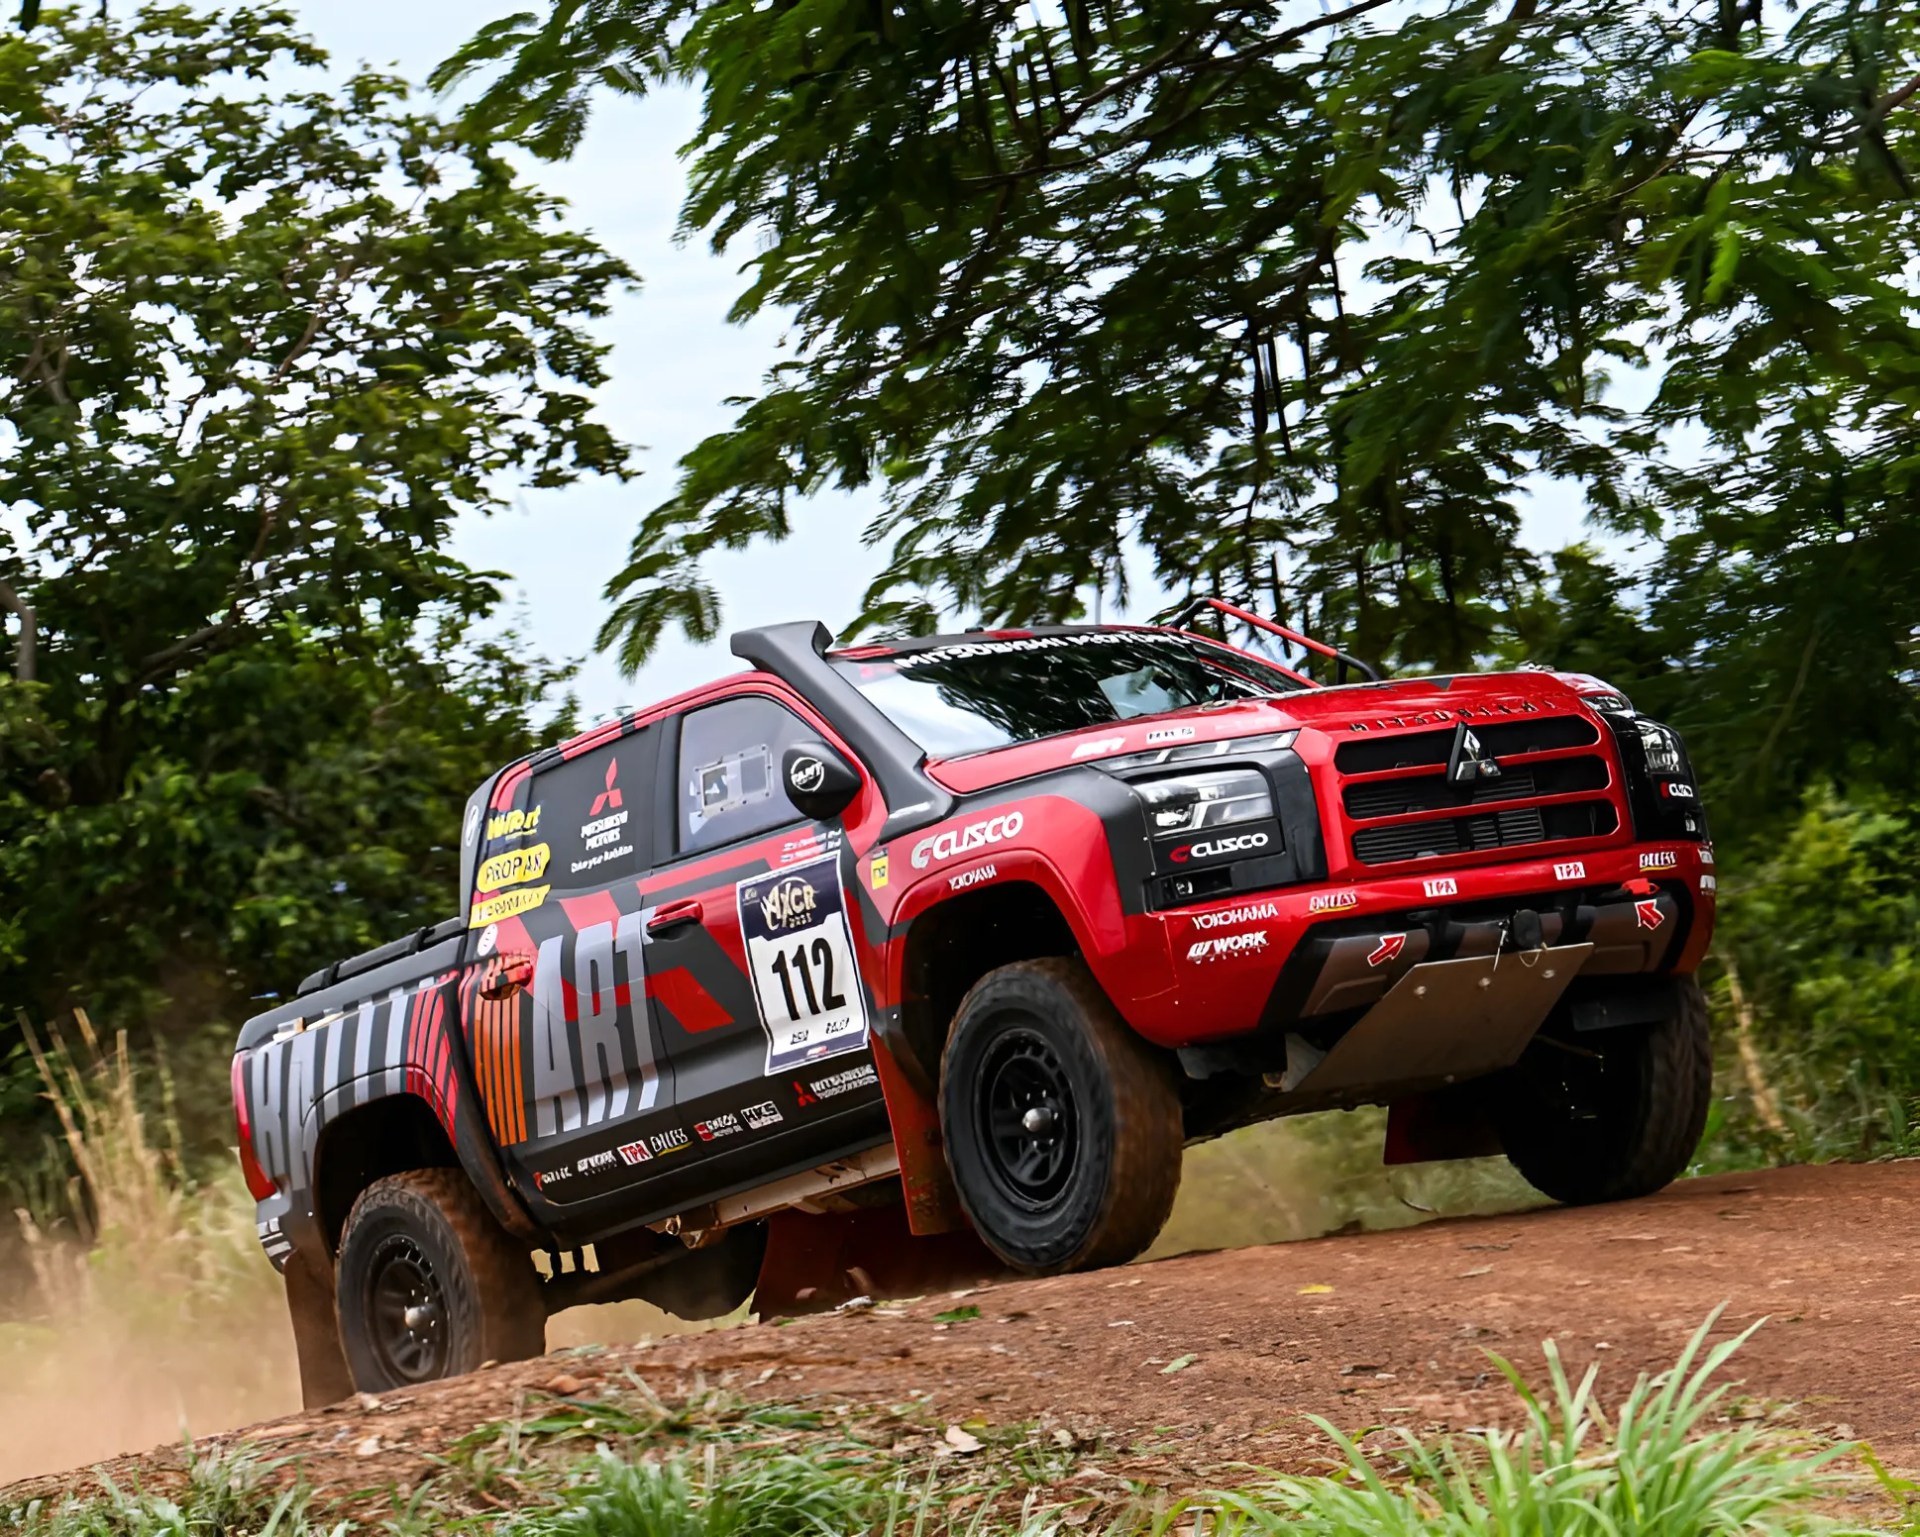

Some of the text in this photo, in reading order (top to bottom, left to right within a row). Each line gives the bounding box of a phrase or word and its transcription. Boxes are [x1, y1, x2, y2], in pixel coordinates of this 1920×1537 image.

[931, 811, 1024, 860] CUSCO
[1190, 832, 1269, 858] CUSCO
[761, 882, 817, 931] AXCR
[1192, 902, 1279, 930] YOKOHAMA
[1213, 931, 1268, 954] WORK
[771, 937, 847, 1021] 112
[742, 1102, 778, 1123] HKS
